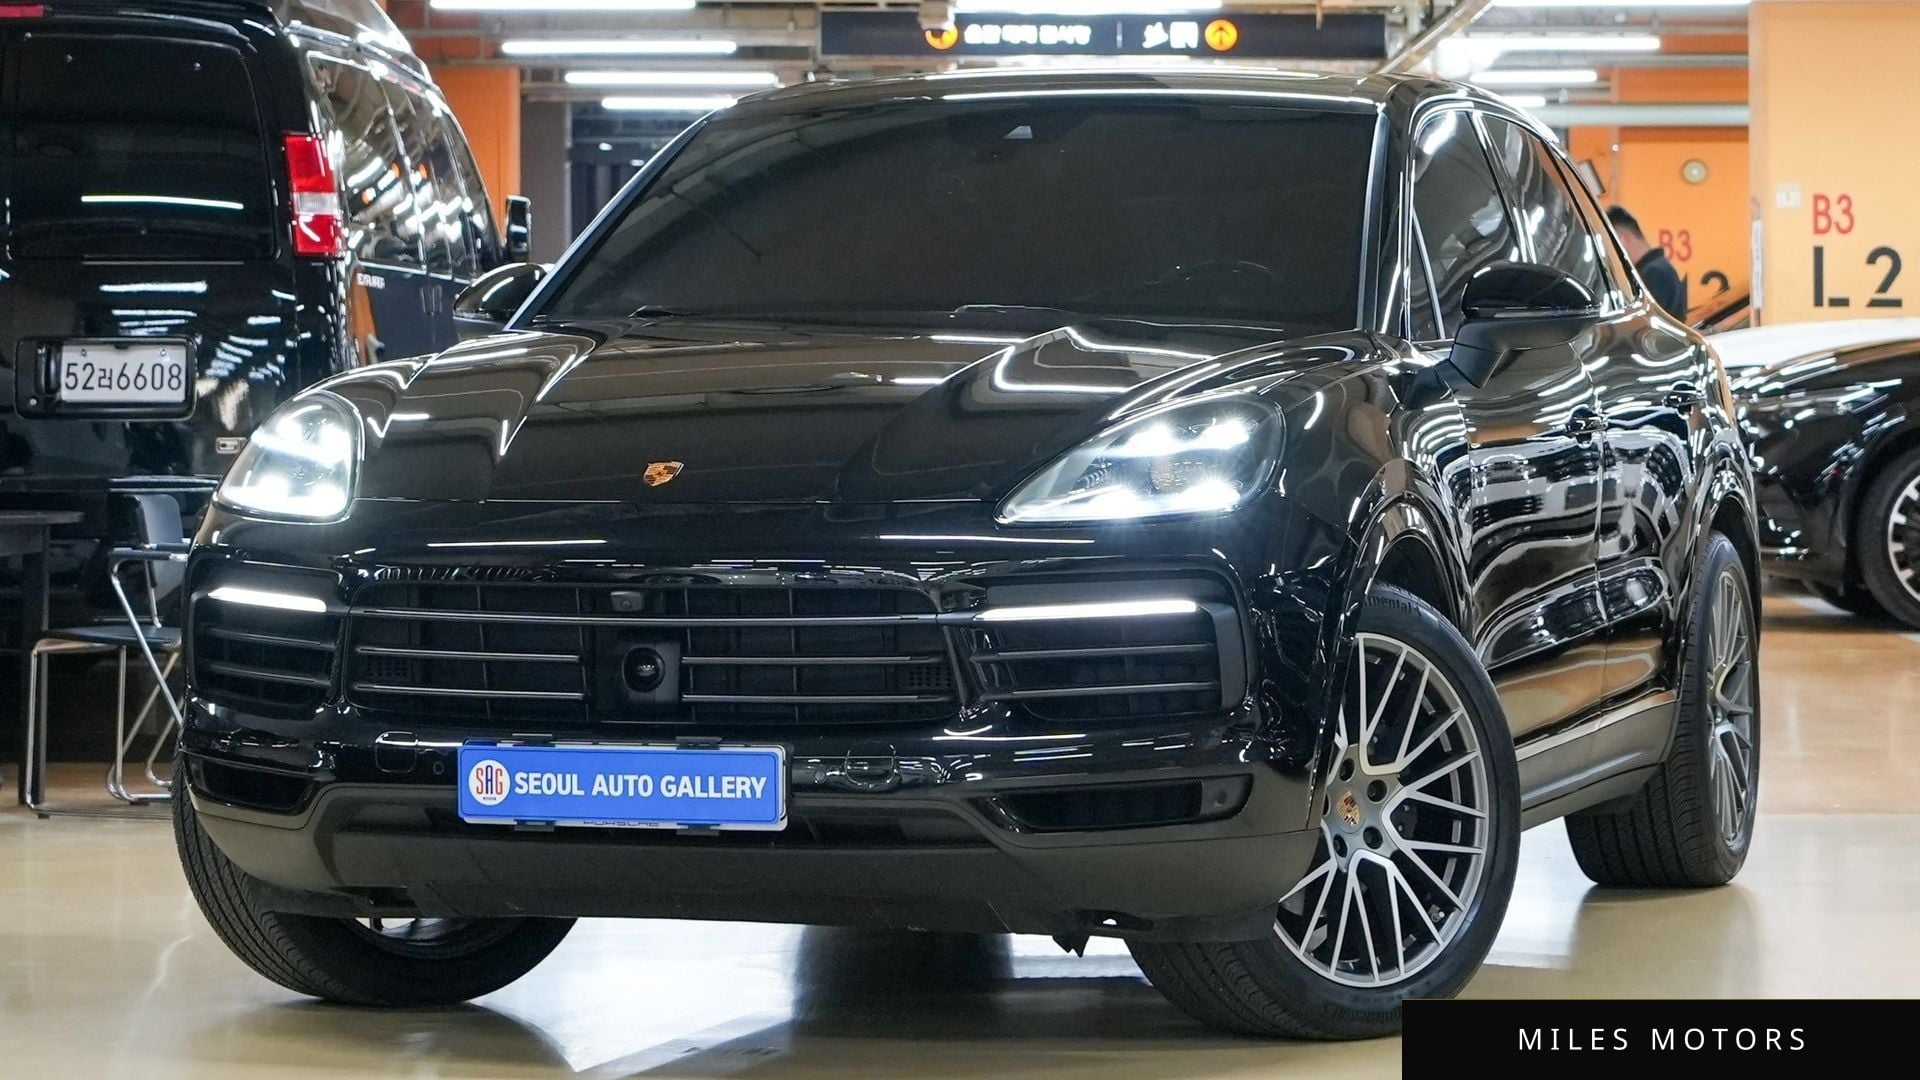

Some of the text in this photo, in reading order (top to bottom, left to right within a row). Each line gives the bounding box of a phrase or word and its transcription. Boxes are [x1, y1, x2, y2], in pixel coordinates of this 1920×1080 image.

[1813, 194, 1854, 235] B3
[65, 362, 182, 391] 52러6608
[475, 764, 504, 795] SAG
[514, 772, 767, 799] SEOUL AUTO GALLERY
